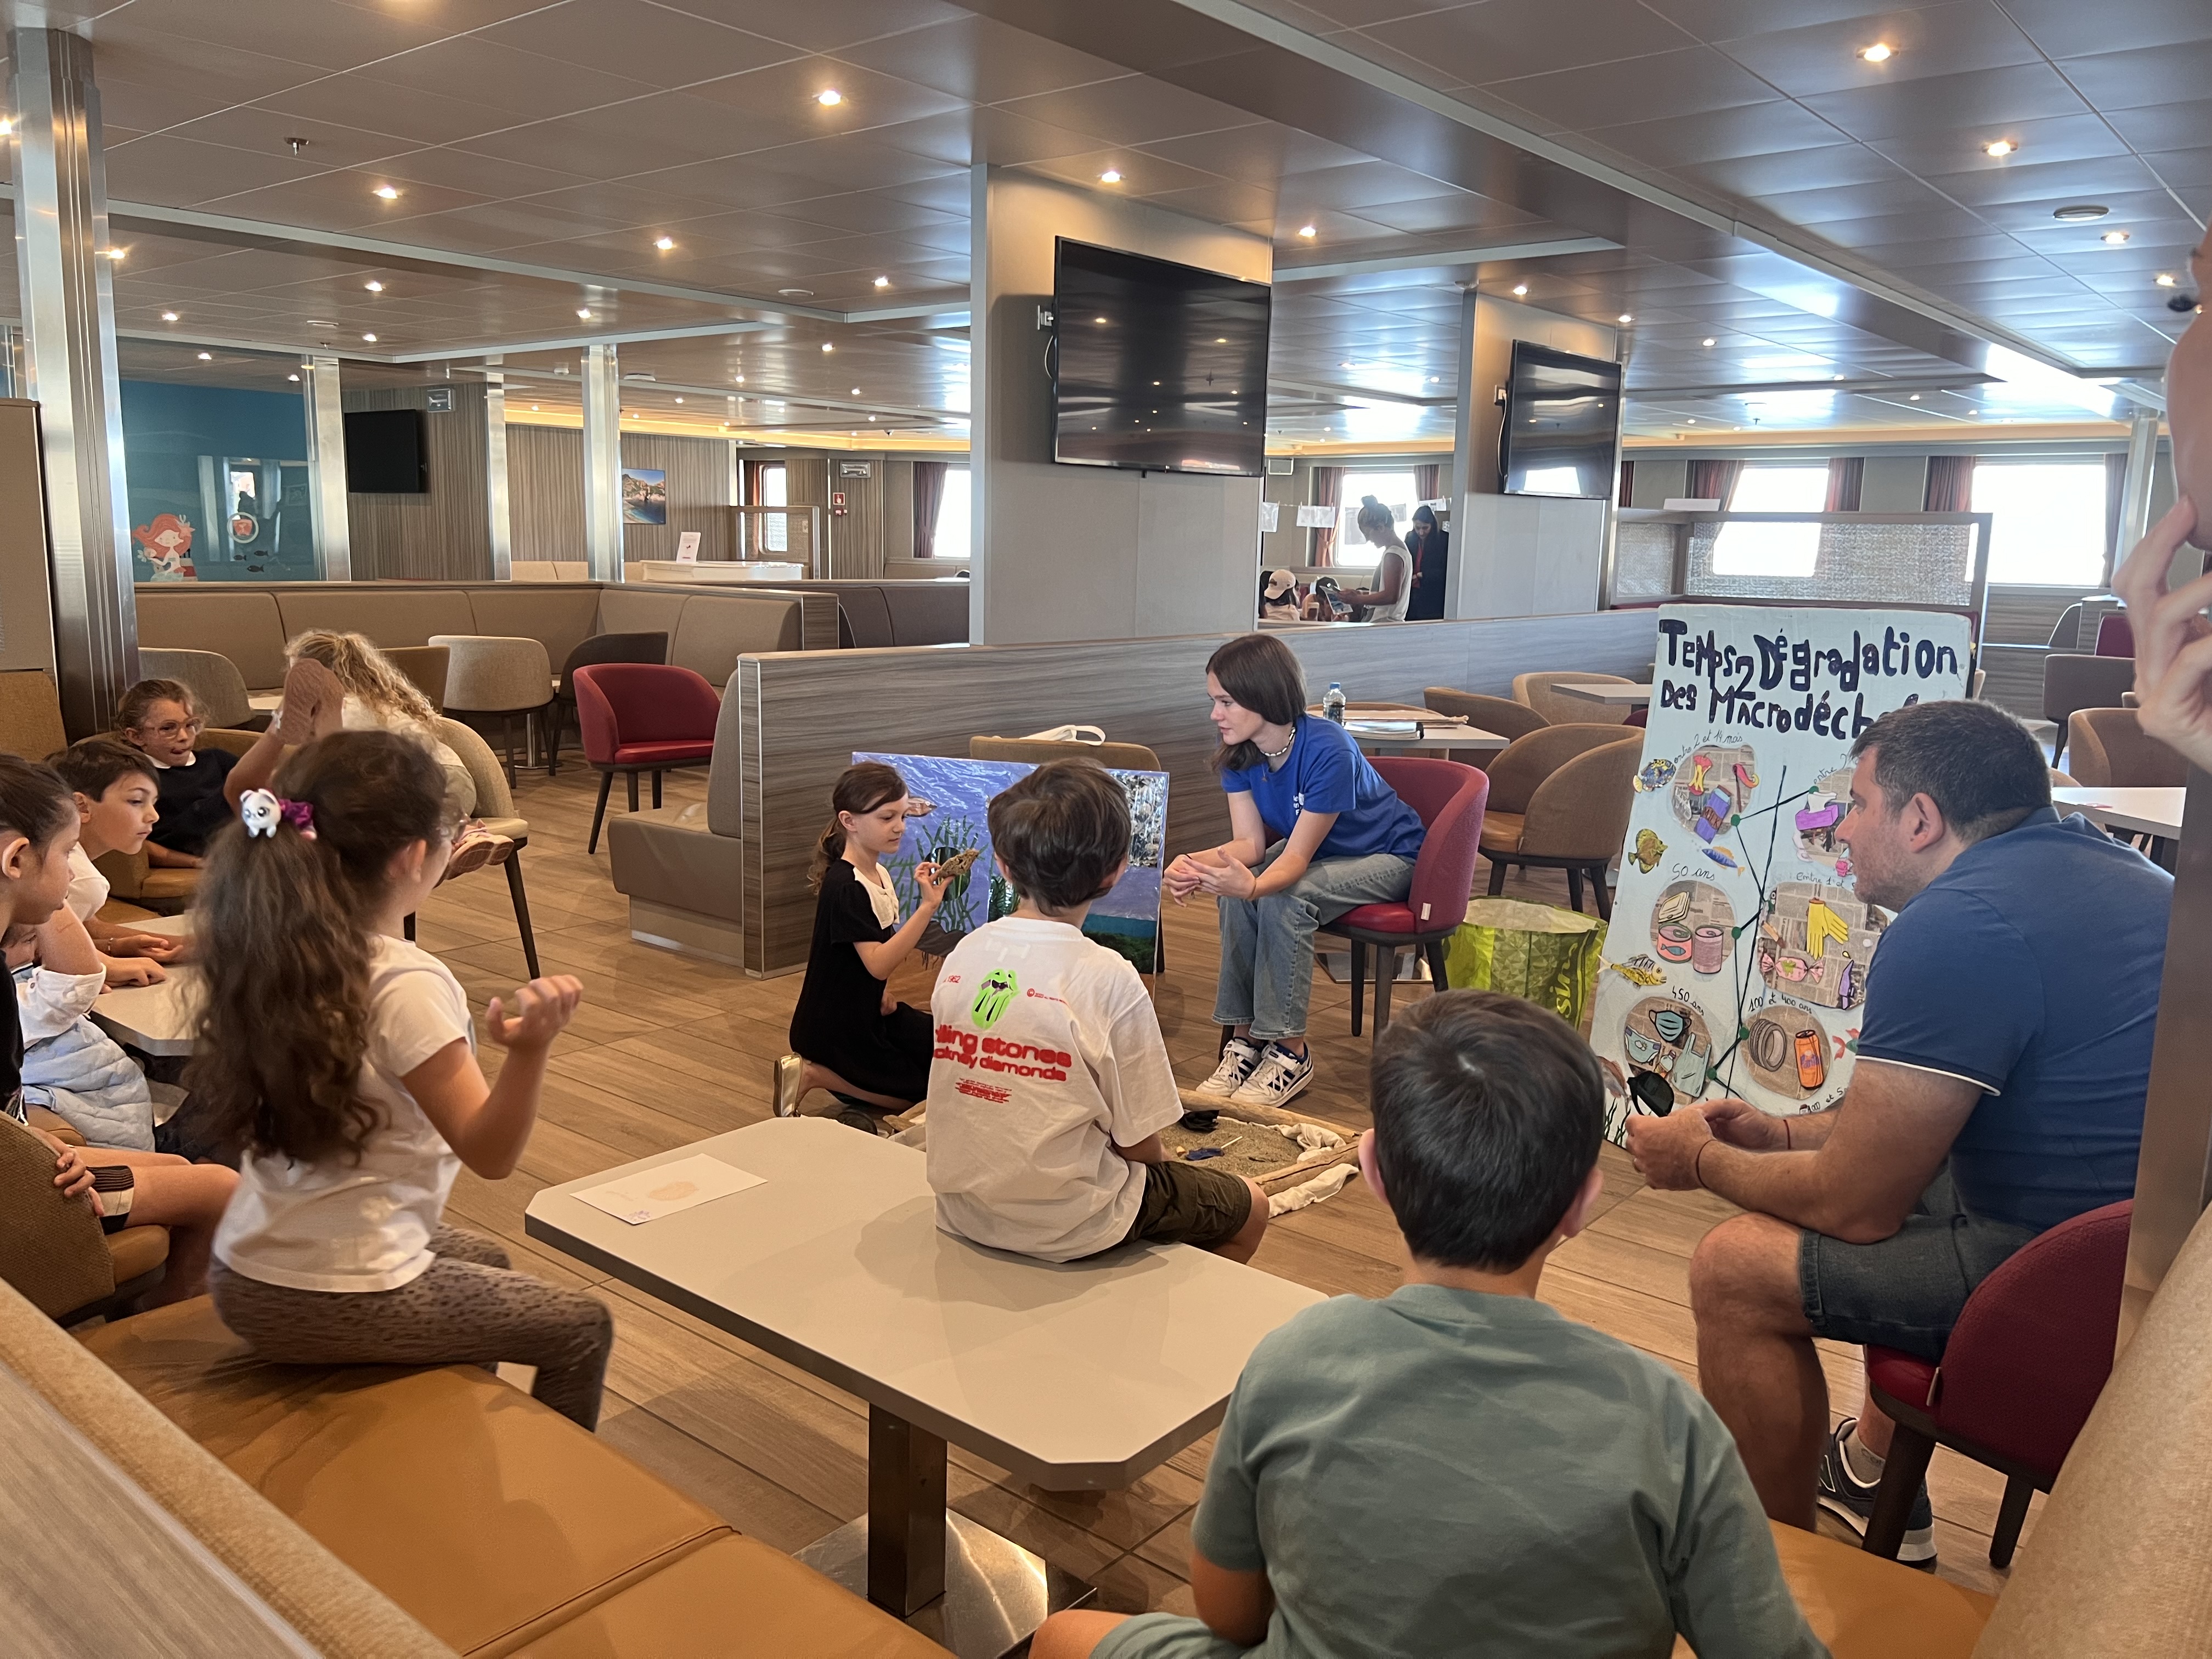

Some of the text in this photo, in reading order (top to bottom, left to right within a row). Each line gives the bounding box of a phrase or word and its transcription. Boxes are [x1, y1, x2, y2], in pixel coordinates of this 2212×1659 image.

[1735, 656, 1756, 701] 2
[1753, 626, 1957, 691] Dégradation
[1674, 744, 1692, 764] entre
[1694, 733, 1700, 749] 2
[1702, 729, 1712, 742] et
[1714, 729, 1723, 743] 14
[1814, 767, 1837, 785] entre
[1672, 863, 1715, 881] 50 ans
[1672, 985, 1704, 1016] 450 ans
[1748, 996, 1763, 1012] 100
[1781, 993, 1796, 1006] 400
[1799, 1003, 1812, 1014] ans
